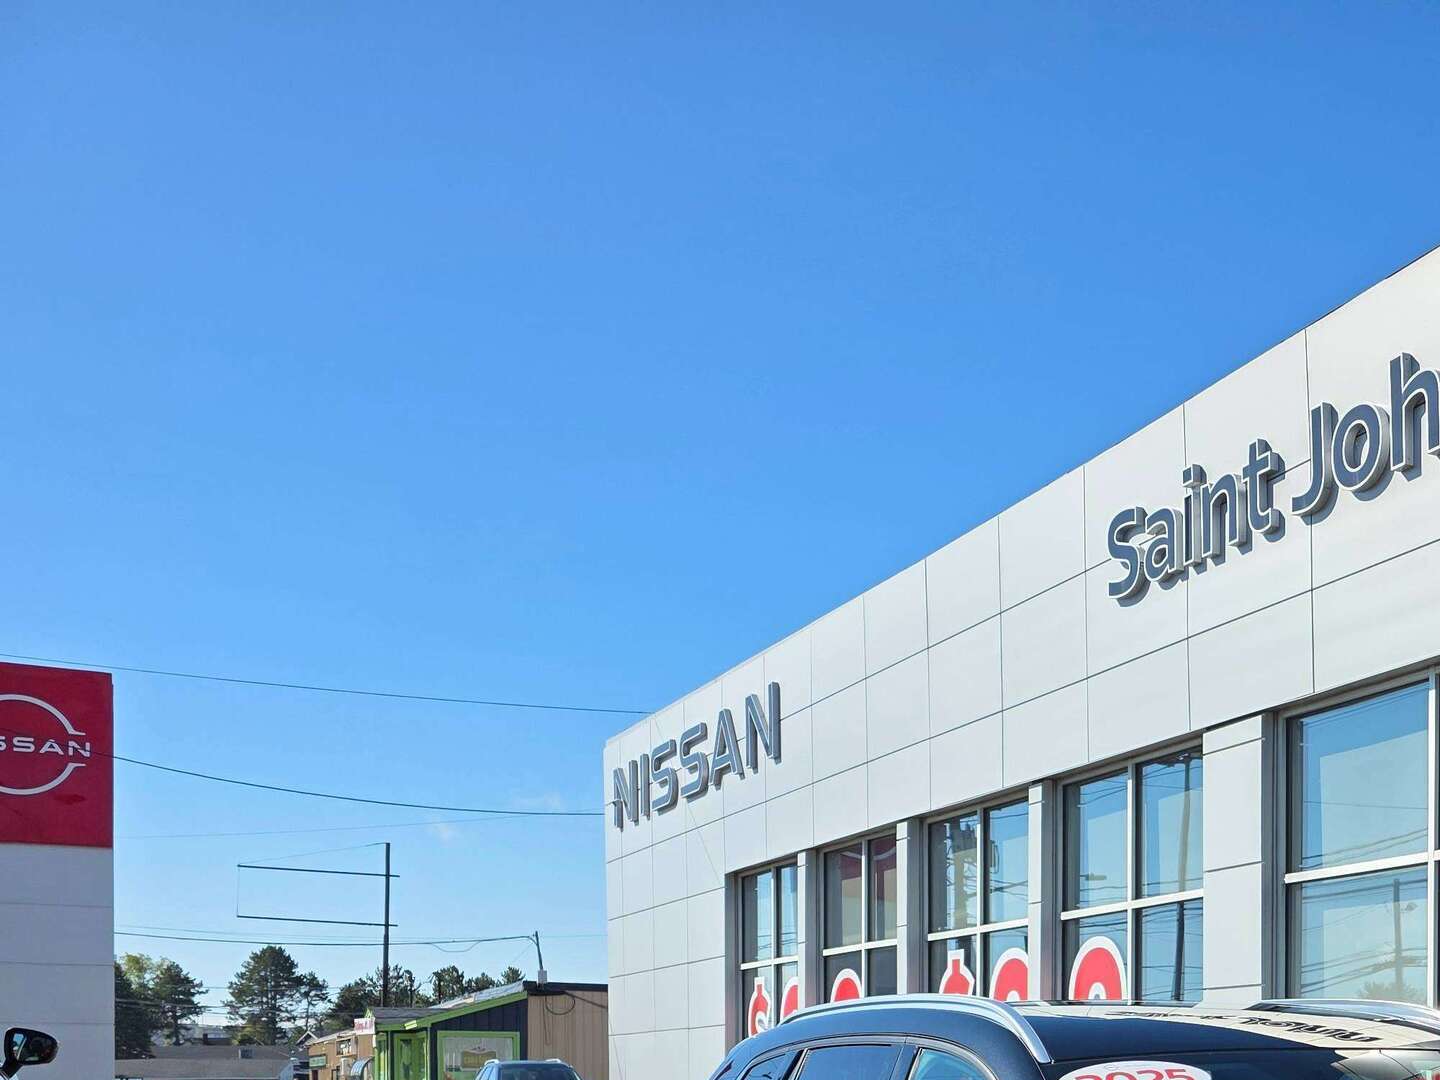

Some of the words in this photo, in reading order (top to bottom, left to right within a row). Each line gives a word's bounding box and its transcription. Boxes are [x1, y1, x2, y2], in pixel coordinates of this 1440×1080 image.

[1107, 438, 1284, 603] Saint
[0, 735, 91, 758] SAN
[612, 682, 781, 831] NISSAN
